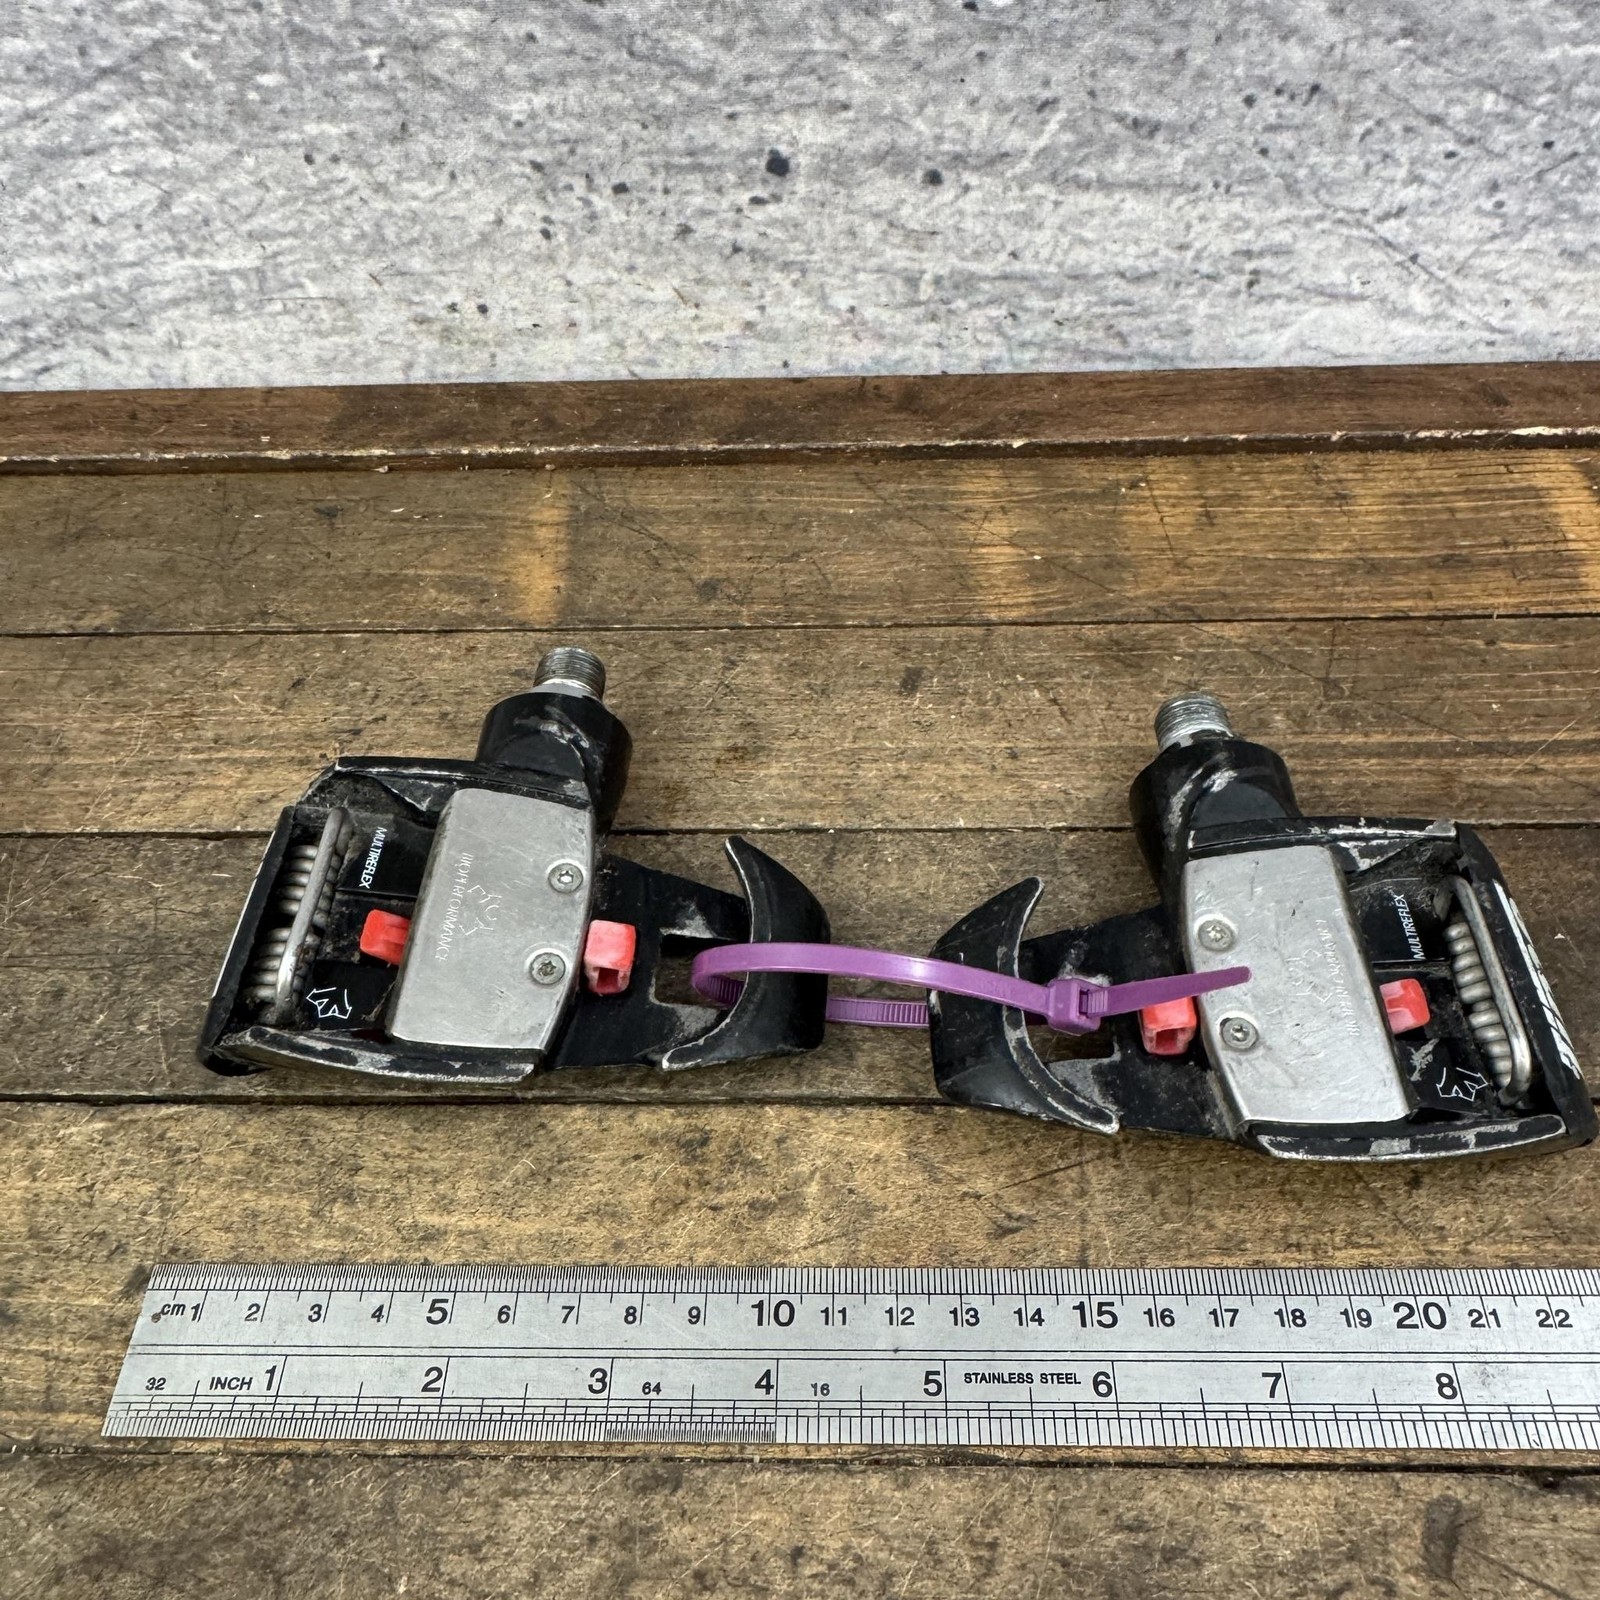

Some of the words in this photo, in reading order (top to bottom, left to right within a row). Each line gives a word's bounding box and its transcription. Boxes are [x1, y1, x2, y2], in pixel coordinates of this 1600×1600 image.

[359, 826, 388, 889] MULTIREFLEX
[1395, 894, 1425, 960] MULTIREFLEX
[161, 1302, 185, 1317] cm
[190, 1303, 201, 1321] 1
[244, 1303, 261, 1322] 2
[307, 1304, 323, 1322] 3
[371, 1304, 385, 1323] 4
[426, 1299, 450, 1325] 5
[497, 1305, 511, 1324] 6
[561, 1306, 575, 1324] 7
[623, 1306, 637, 1325] 8
[687, 1306, 701, 1325] 9
[751, 1300, 795, 1327] 10
[820, 1307, 848, 1326] 11
[885, 1307, 915, 1327] 12
[949, 1307, 981, 1327] 13
[1013, 1307, 1045, 1327] 14
[1072, 1302, 1118, 1329] 15
[1143, 1308, 1175, 1328] 16
[1208, 1309, 1239, 1328] 17
[1274, 1308, 1307, 1328] 18
[1340, 1308, 1373, 1329] 19
[1393, 1302, 1447, 1330] 20
[1468, 1309, 1501, 1329] 21
[1535, 1309, 1573, 1329] 22
[145, 1377, 165, 1391] 32
[209, 1376, 252, 1391] INCH
[264, 1366, 277, 1391] 1
[421, 1366, 443, 1393] 2
[588, 1368, 608, 1394] 3
[754, 1369, 774, 1396] 4
[923, 1370, 943, 1397] 5
[1092, 1371, 1113, 1398] 6
[1261, 1372, 1283, 1399] 7
[1436, 1372, 1458, 1400] 8
[641, 1381, 662, 1396] 64
[811, 1383, 830, 1397] 16
[964, 1373, 1034, 1386] STAINLESS
[1039, 1373, 1081, 1386] STEEL
